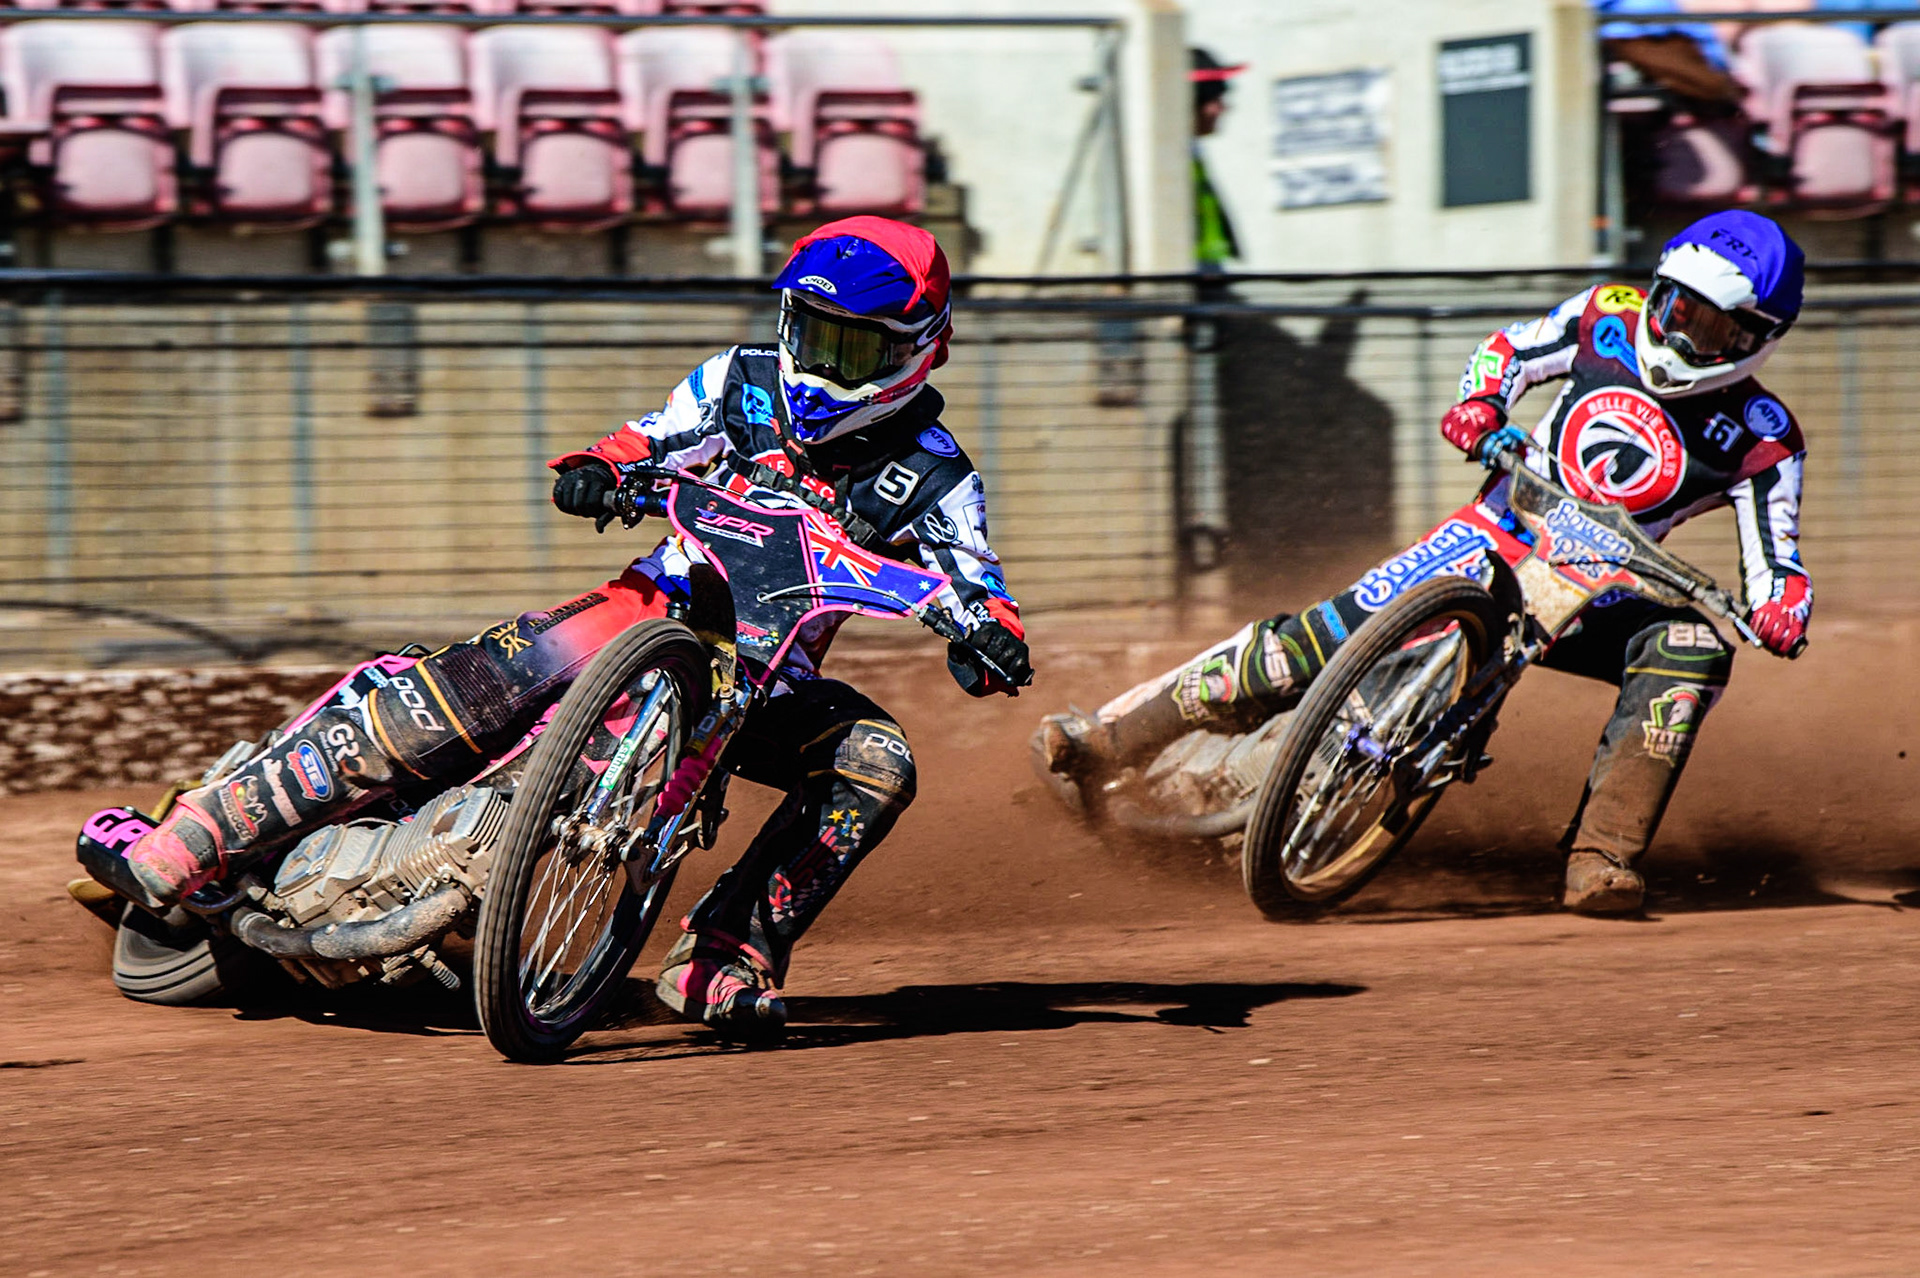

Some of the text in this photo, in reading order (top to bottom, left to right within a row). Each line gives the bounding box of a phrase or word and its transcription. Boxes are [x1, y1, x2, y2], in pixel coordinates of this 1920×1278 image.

[1586, 396, 1632, 416] BELLE
[925, 428, 952, 451] ATPI
[878, 466, 914, 500] 5
[695, 514, 776, 548] JPR
[1548, 502, 1632, 556] Bowen
[1356, 520, 1475, 607] Bowen
